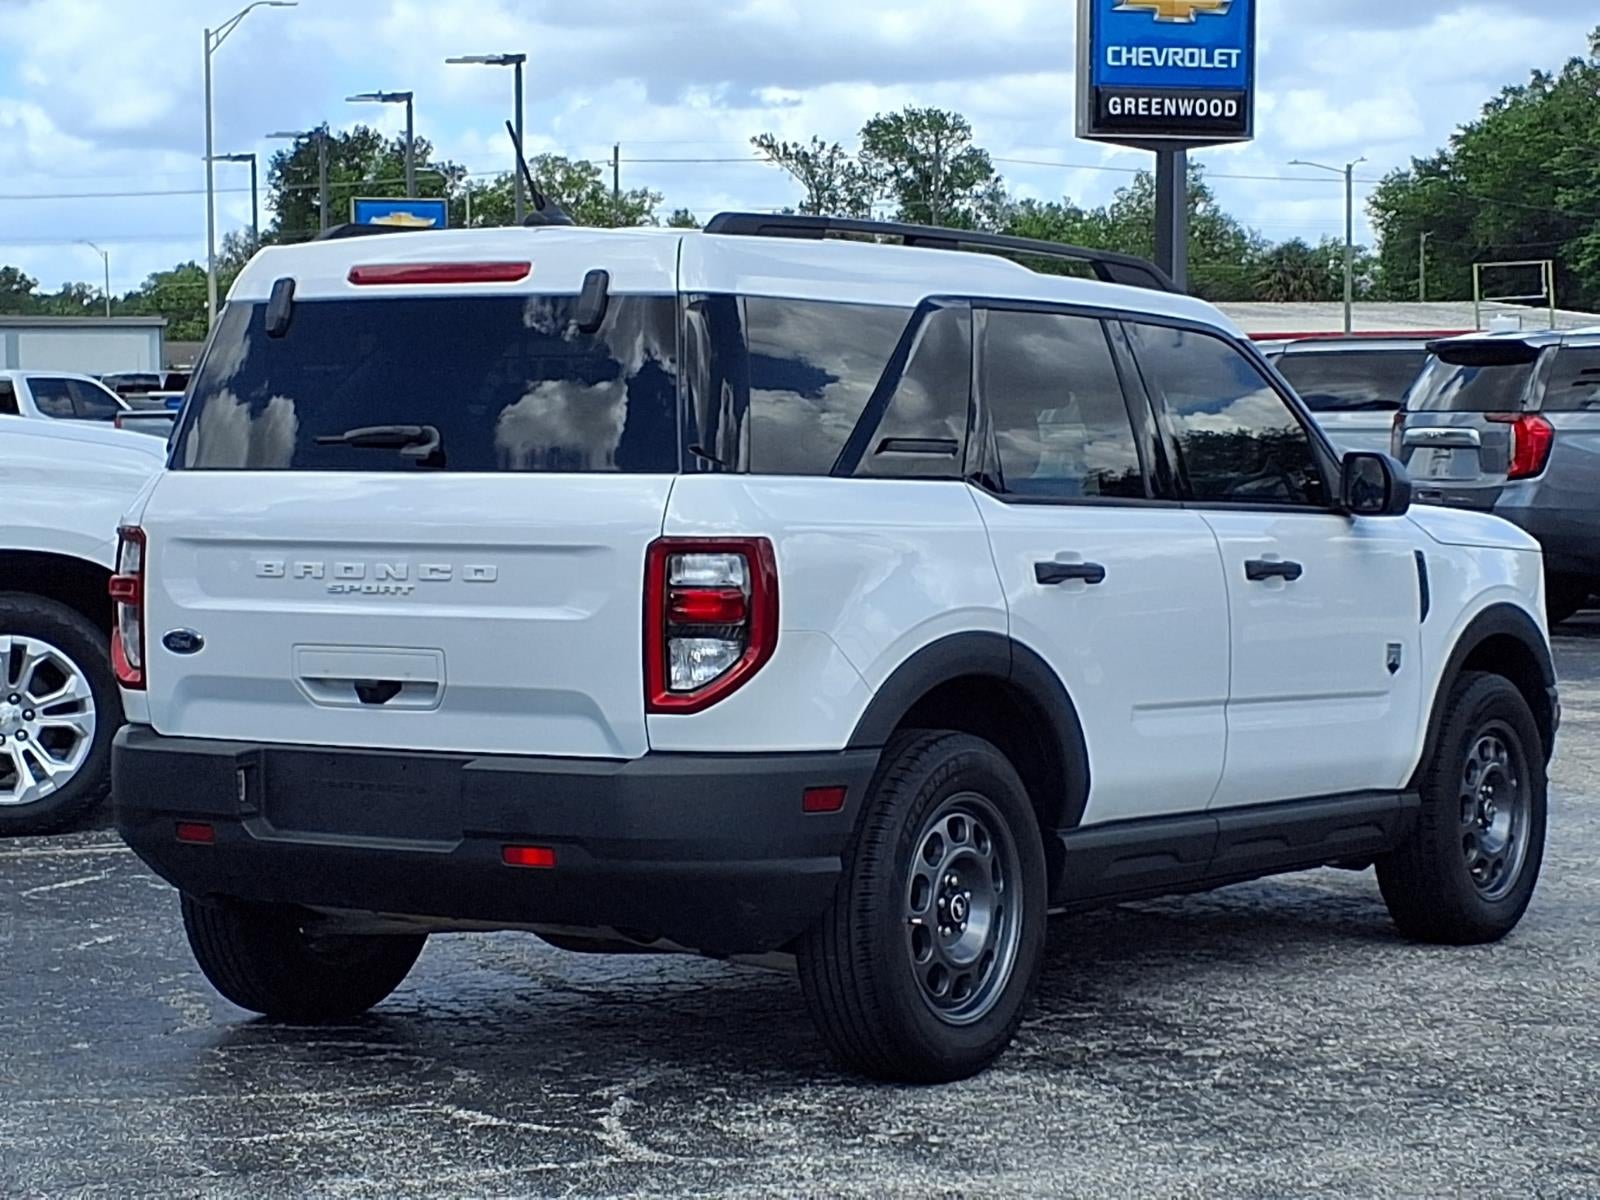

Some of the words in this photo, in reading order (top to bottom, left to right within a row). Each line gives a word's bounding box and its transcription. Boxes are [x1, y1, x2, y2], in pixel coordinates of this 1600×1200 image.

[1106, 46, 1241, 69] CHEVROLET
[1108, 97, 1237, 117] GREENWOOD
[255, 560, 499, 582] BRONCO
[327, 583, 415, 595] SPORT
